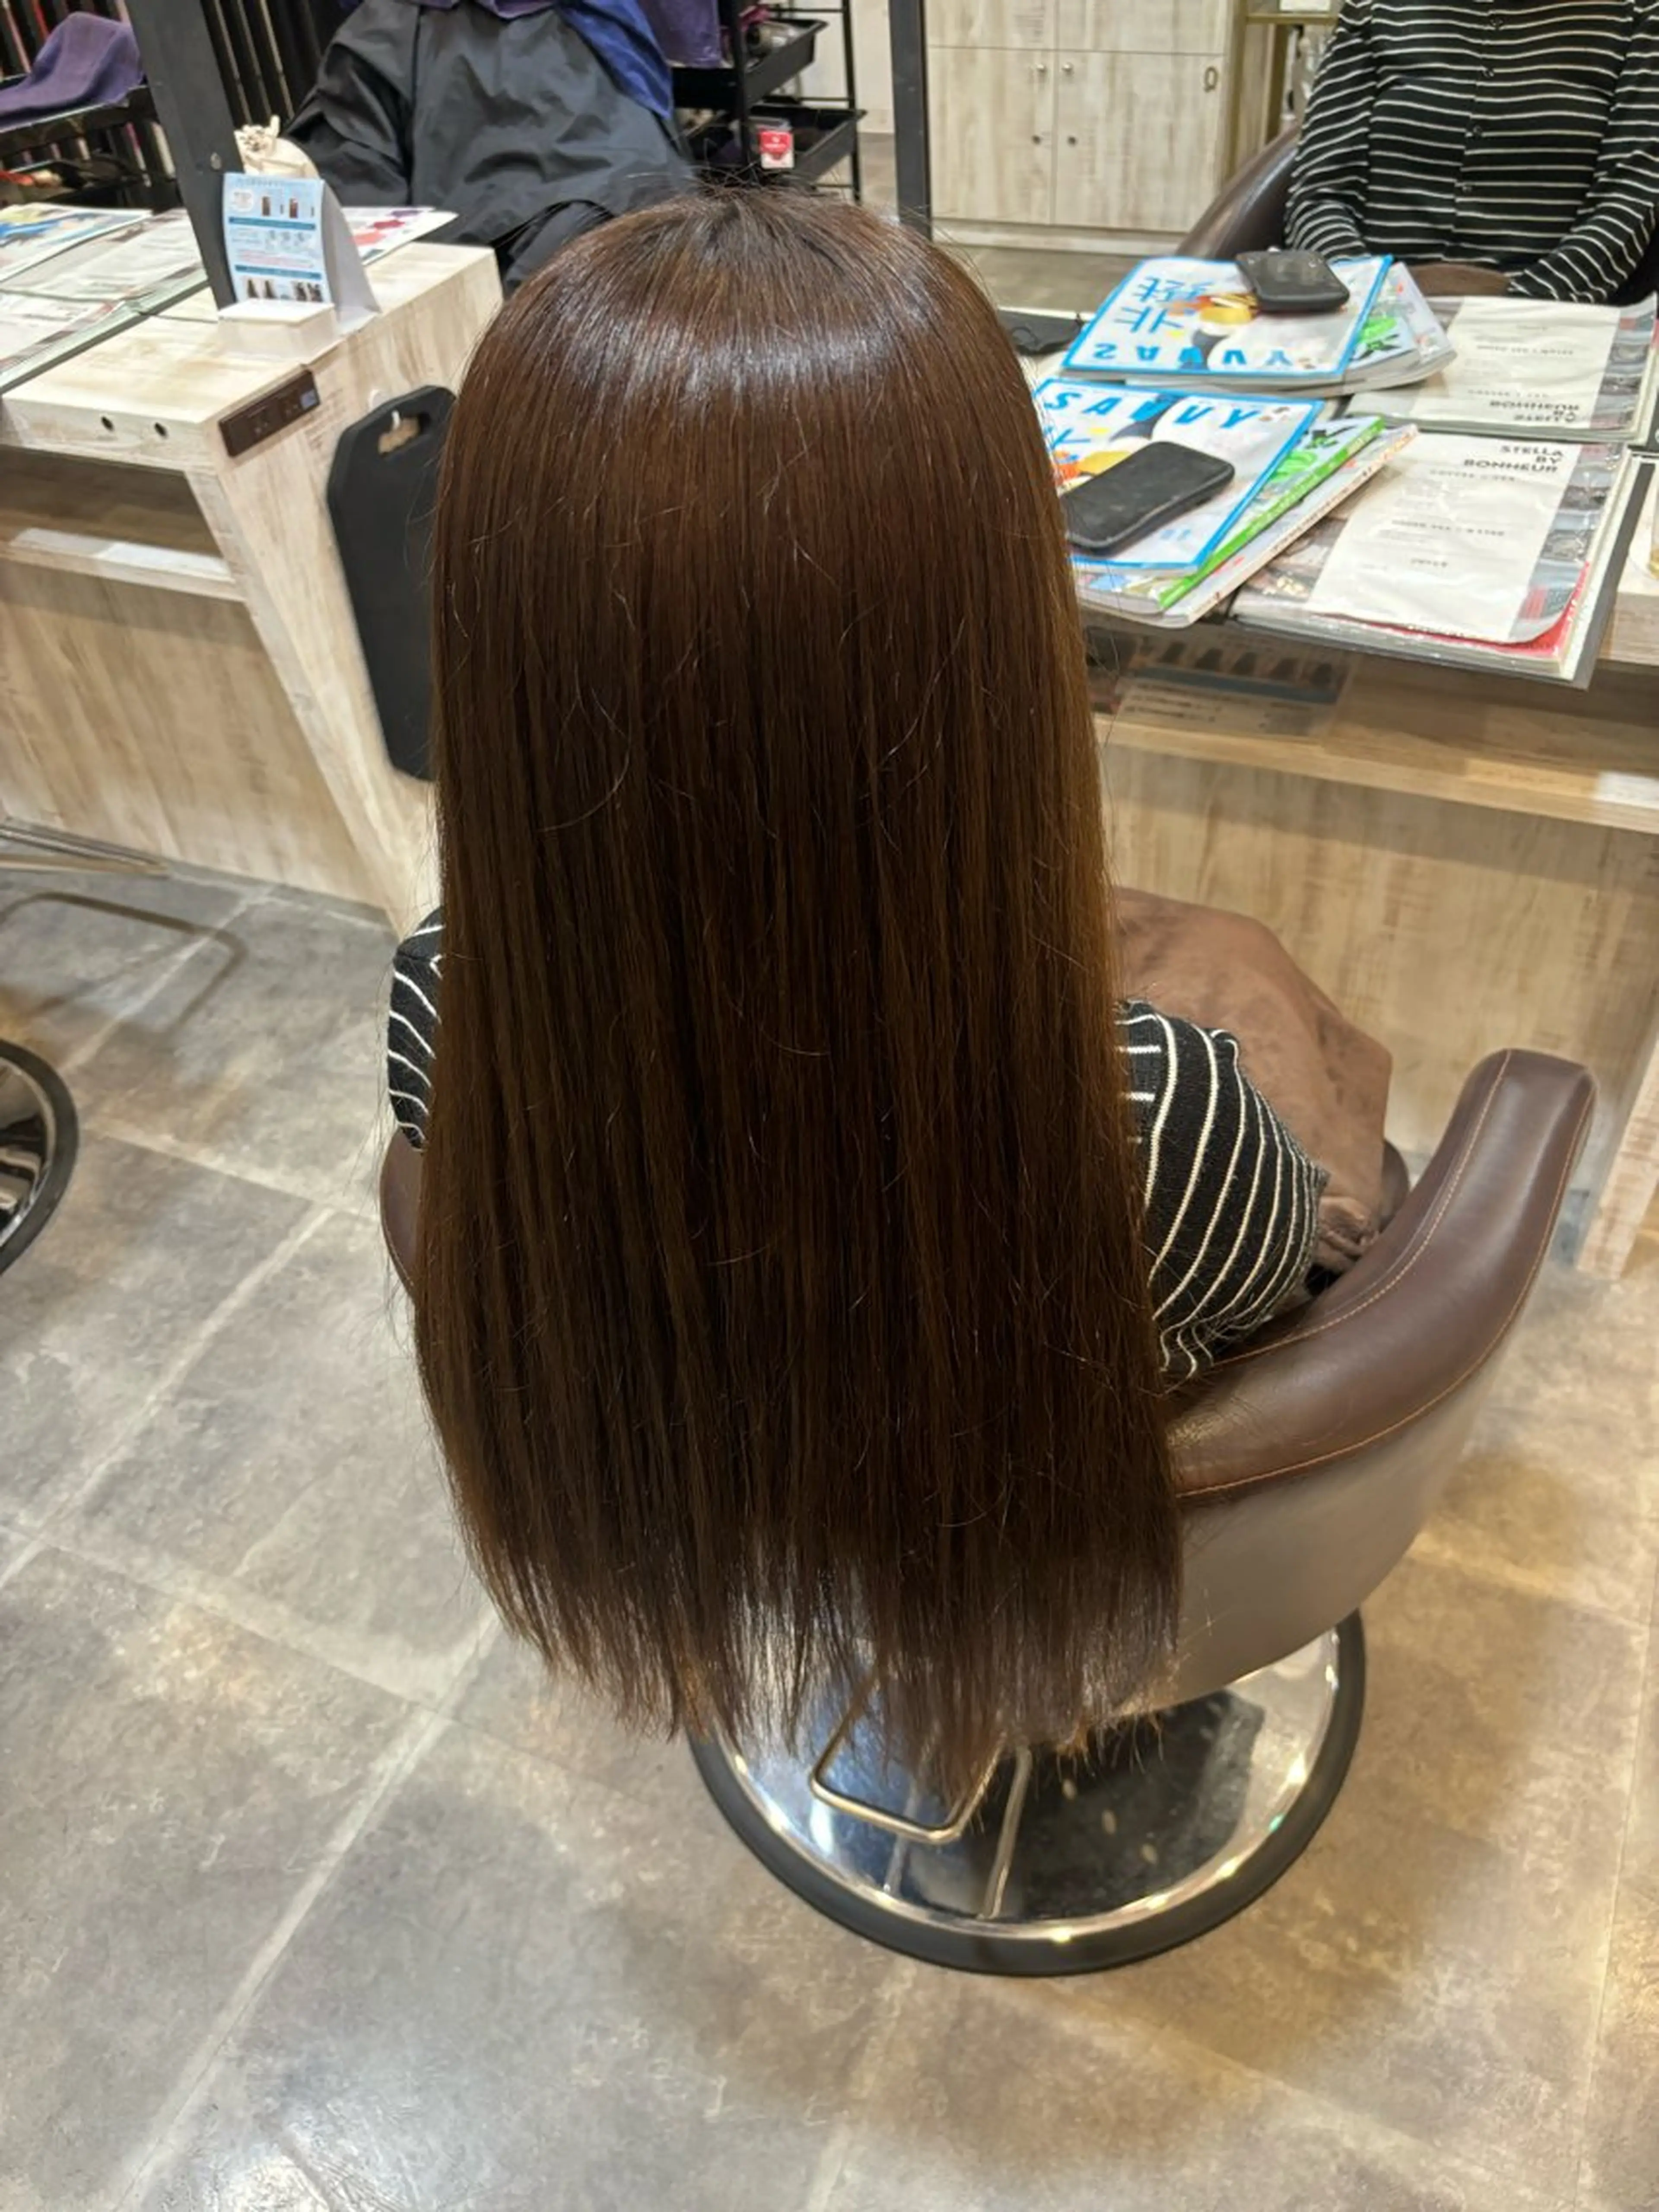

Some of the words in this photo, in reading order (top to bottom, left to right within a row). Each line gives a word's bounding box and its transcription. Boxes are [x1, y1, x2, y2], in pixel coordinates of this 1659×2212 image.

[1044, 391, 1261, 429] SAVVY
[1501, 445, 1563, 456] STELLA
[1463, 458, 1558, 473] BONHEUR
[1535, 455, 1561, 464] BY
